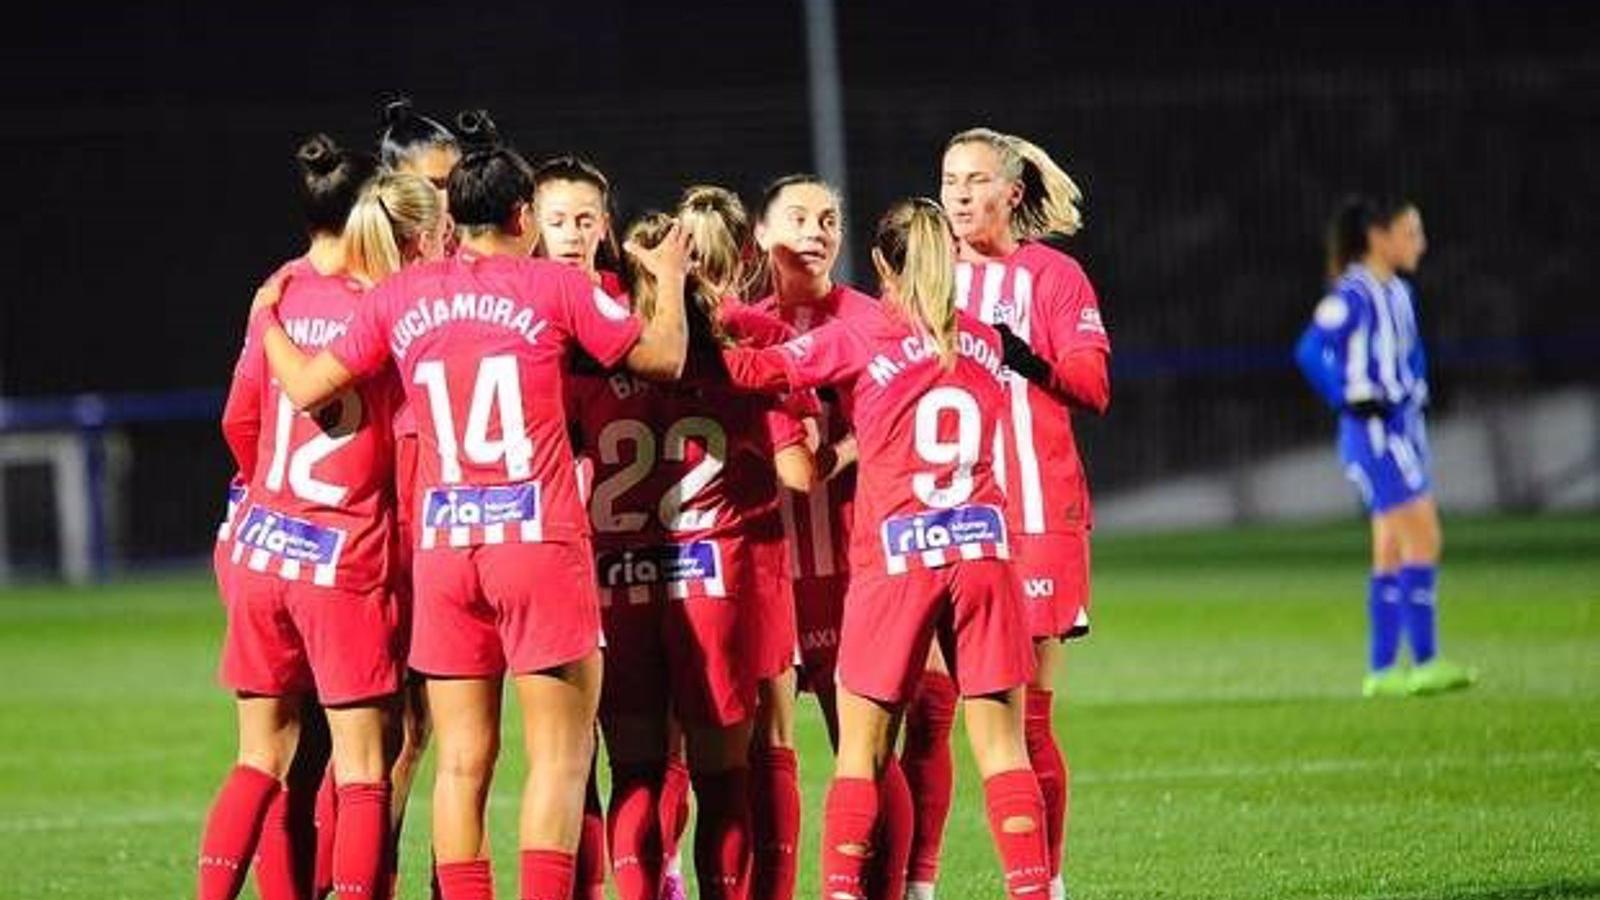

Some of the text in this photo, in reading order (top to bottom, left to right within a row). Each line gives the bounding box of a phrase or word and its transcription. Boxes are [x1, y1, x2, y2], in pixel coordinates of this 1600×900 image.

[265, 378, 362, 507] 12
[414, 355, 533, 484] 14
[911, 386, 981, 509] 9
[434, 491, 481, 524] ria
[590, 416, 727, 531] 22
[244, 514, 288, 553] ria
[607, 551, 657, 585] ria
[899, 517, 951, 552] ria
